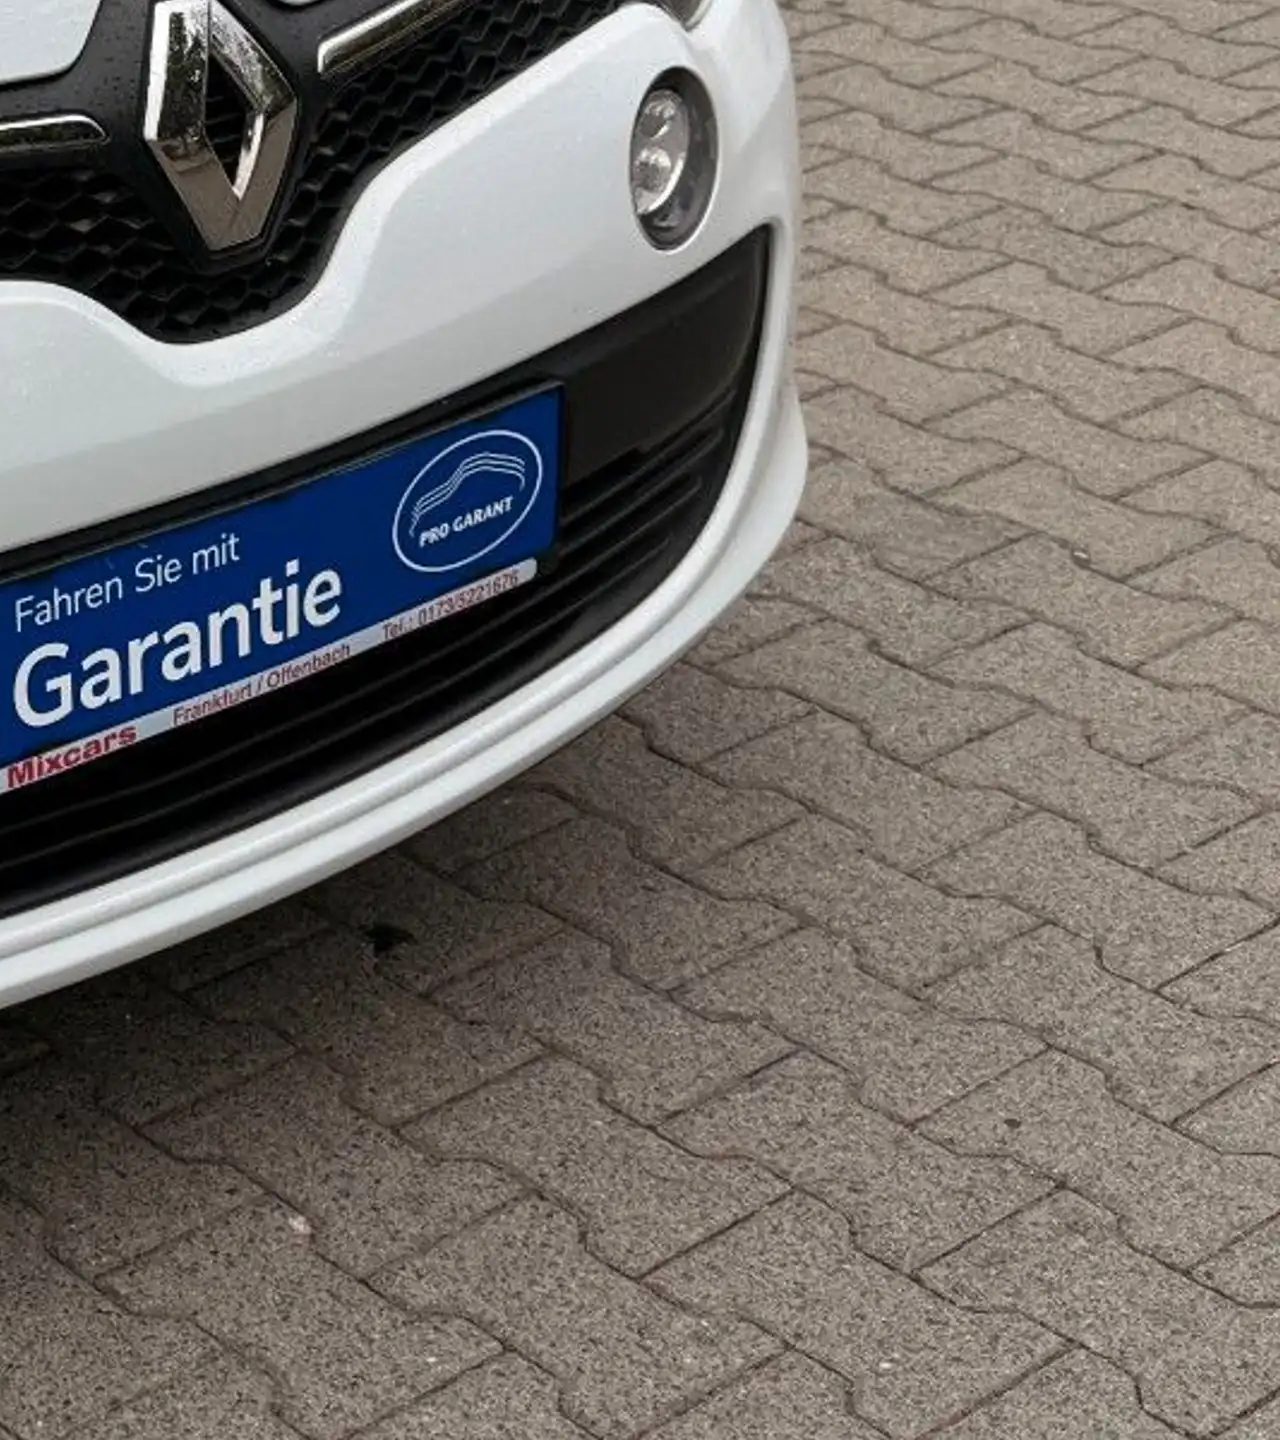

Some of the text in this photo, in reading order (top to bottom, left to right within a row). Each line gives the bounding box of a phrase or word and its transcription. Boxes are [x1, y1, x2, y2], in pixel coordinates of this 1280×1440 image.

[15, 532, 240, 633] Fahren Sie mit
[419, 495, 514, 548] PRO GARANT
[13, 558, 342, 728] Garantie
[6, 724, 138, 790] Mixcars
[174, 682, 252, 726] Frankfurt
[267, 643, 350, 689] Offenbach
